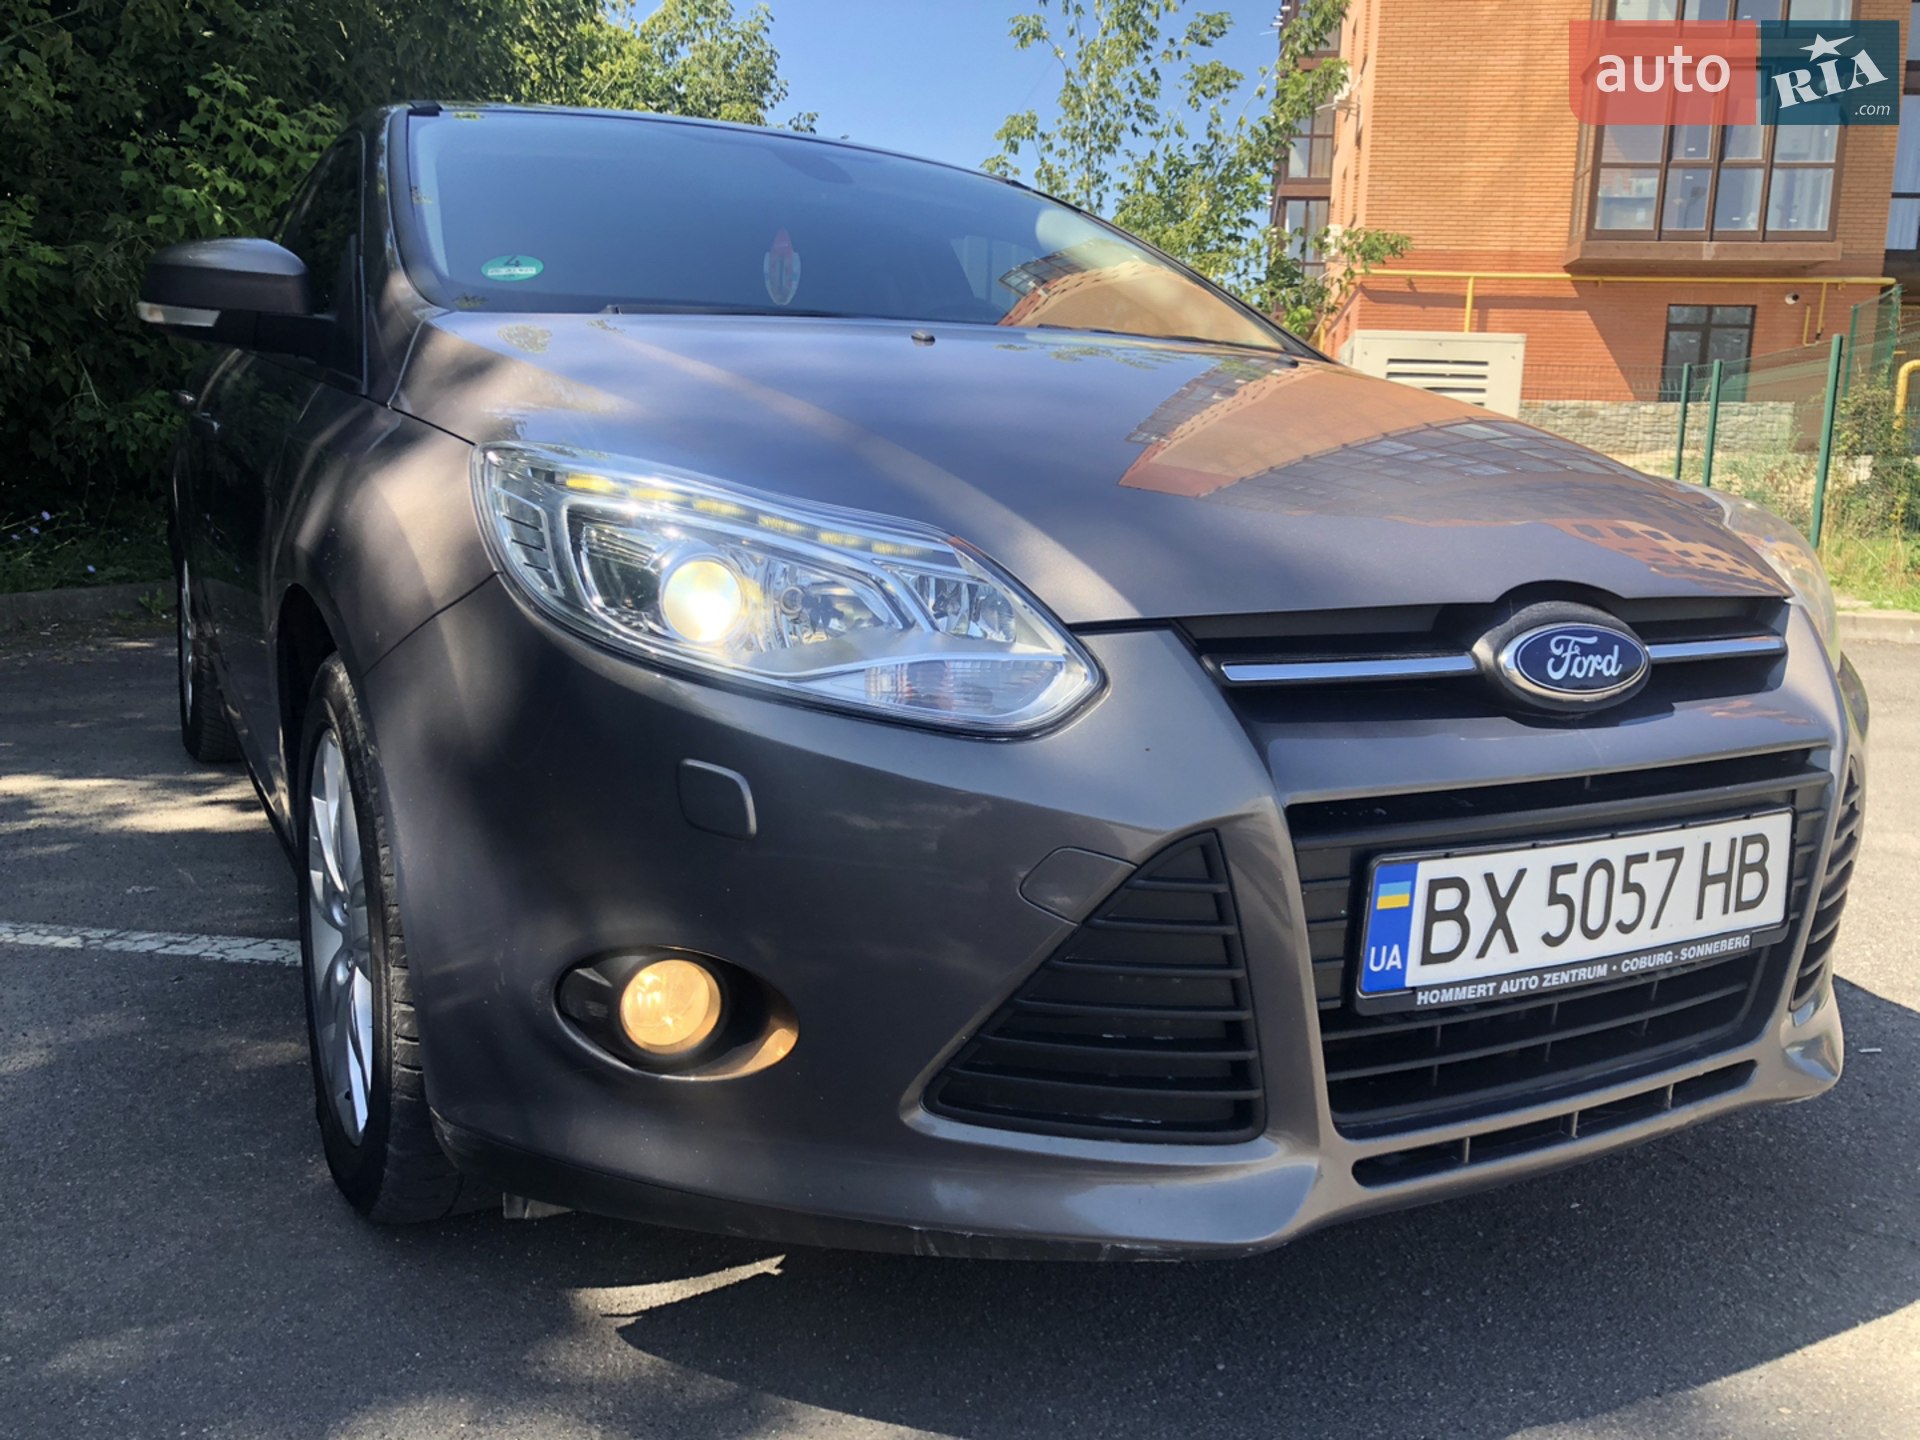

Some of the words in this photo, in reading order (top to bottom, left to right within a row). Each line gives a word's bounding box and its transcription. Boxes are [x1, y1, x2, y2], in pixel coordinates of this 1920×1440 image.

[1546, 635, 1622, 680] Ford
[1420, 867, 1528, 966] BX
[1541, 846, 1685, 948] 5057
[1695, 832, 1770, 921] HB
[1369, 944, 1402, 973] UA
[1416, 982, 1496, 1006] HOMMERT
[1499, 975, 1539, 994] AUTO
[1542, 963, 1608, 988] ZENTRUM
[1621, 951, 1673, 973] COBURG
[1680, 934, 1750, 961] SONNEBERG
